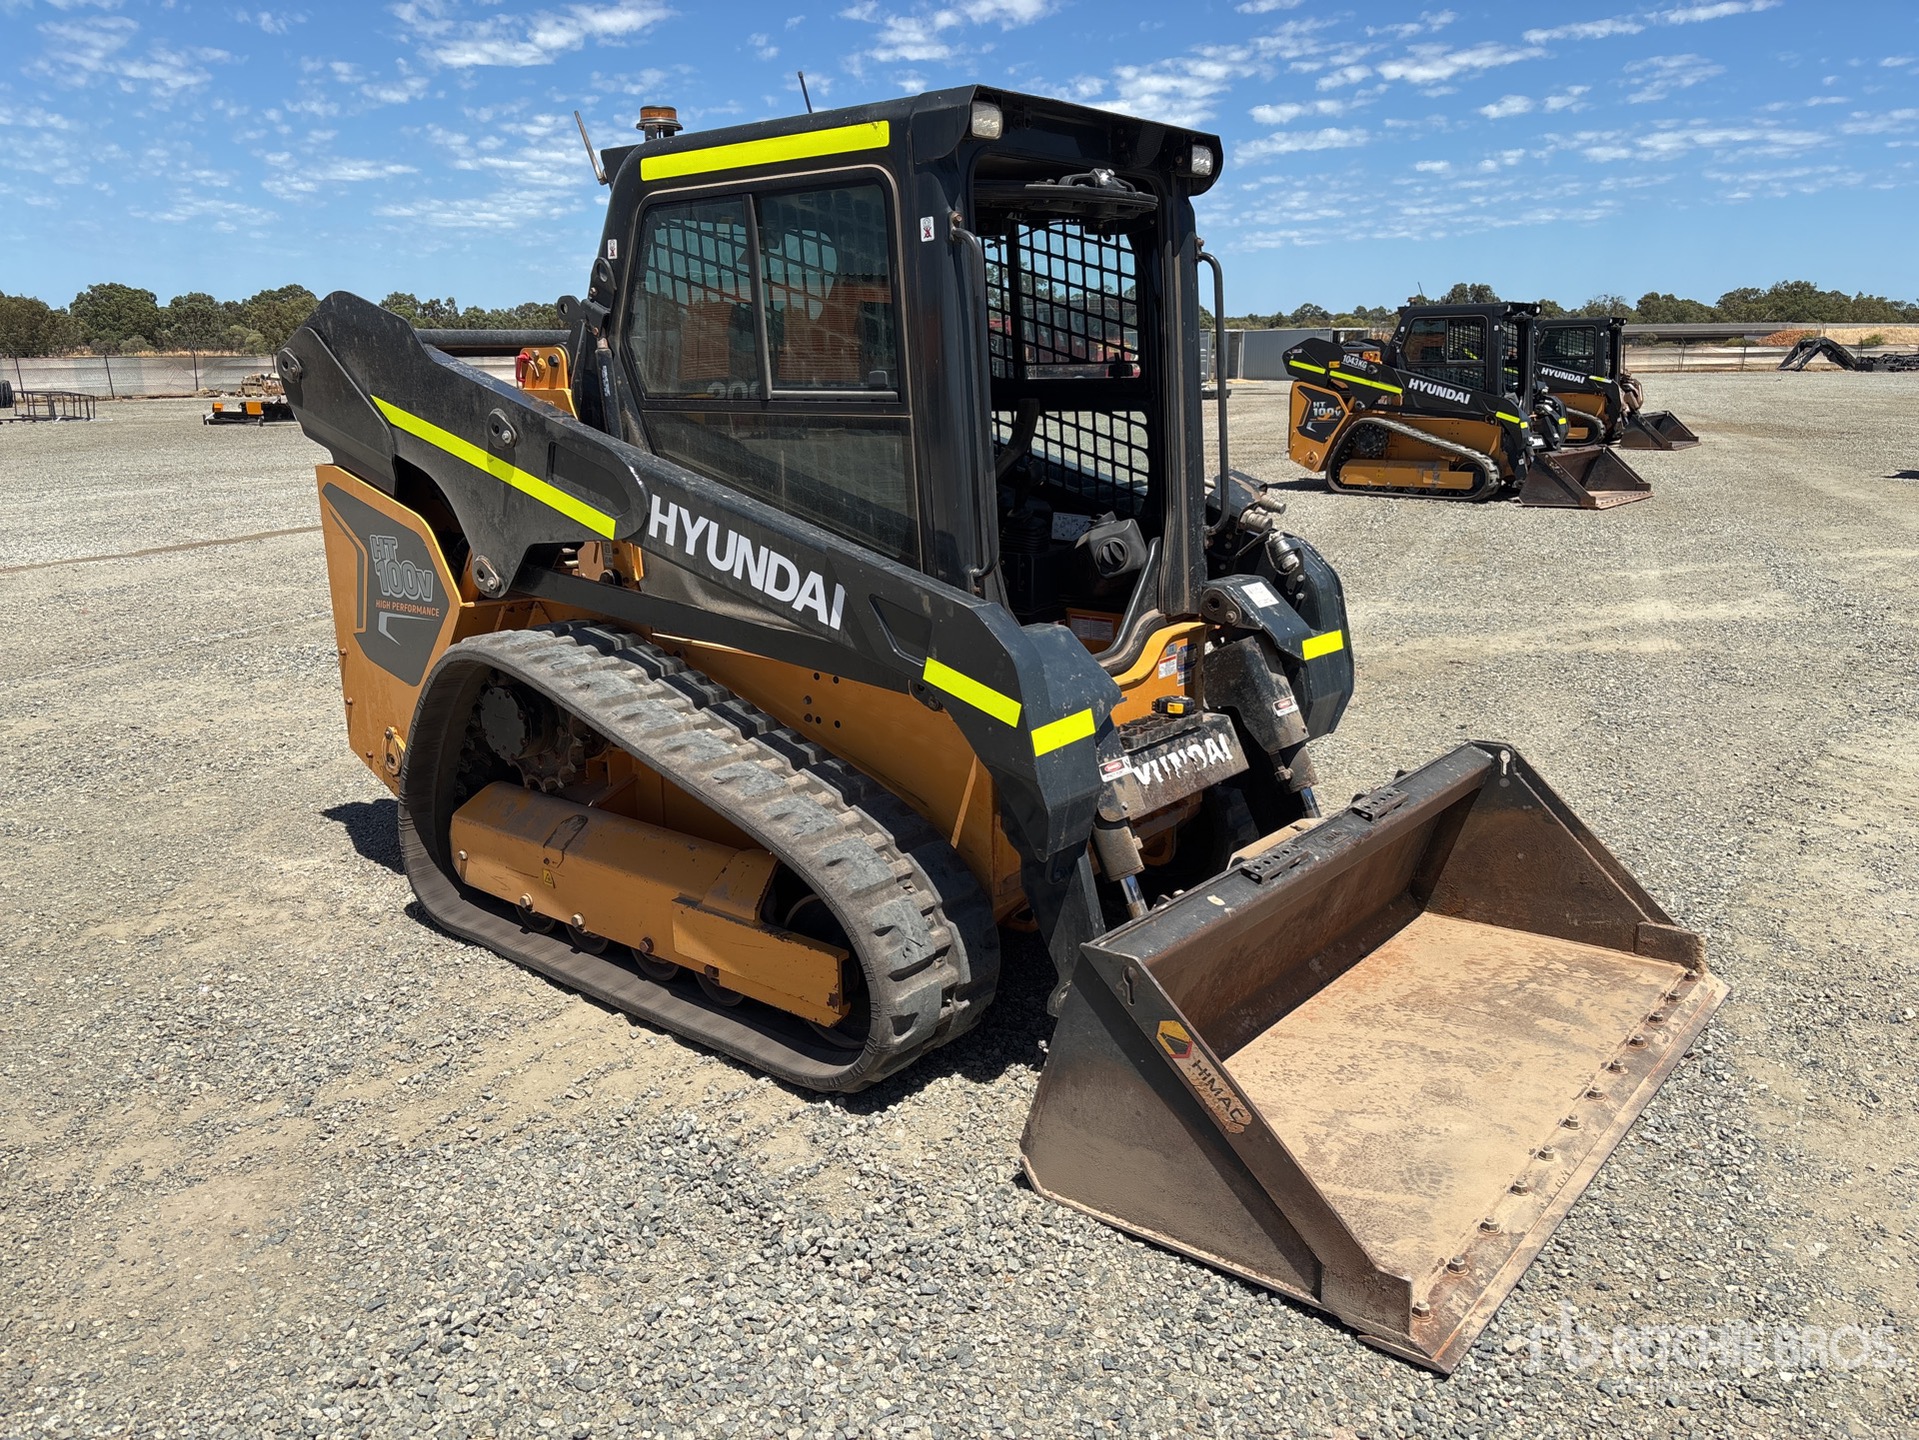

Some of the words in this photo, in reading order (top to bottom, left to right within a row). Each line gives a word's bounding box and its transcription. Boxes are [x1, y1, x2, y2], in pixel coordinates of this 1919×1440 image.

[1540, 367, 1586, 384] HYUNDAI
[1408, 378, 1471, 405] HYUNDAI
[370, 535, 398, 561] HT
[648, 493, 846, 631] HYUNDAI
[375, 599, 391, 610] HIGH
[391, 601, 440, 617] PERFORMANCE
[1191, 1059, 1244, 1123] HIMAC
